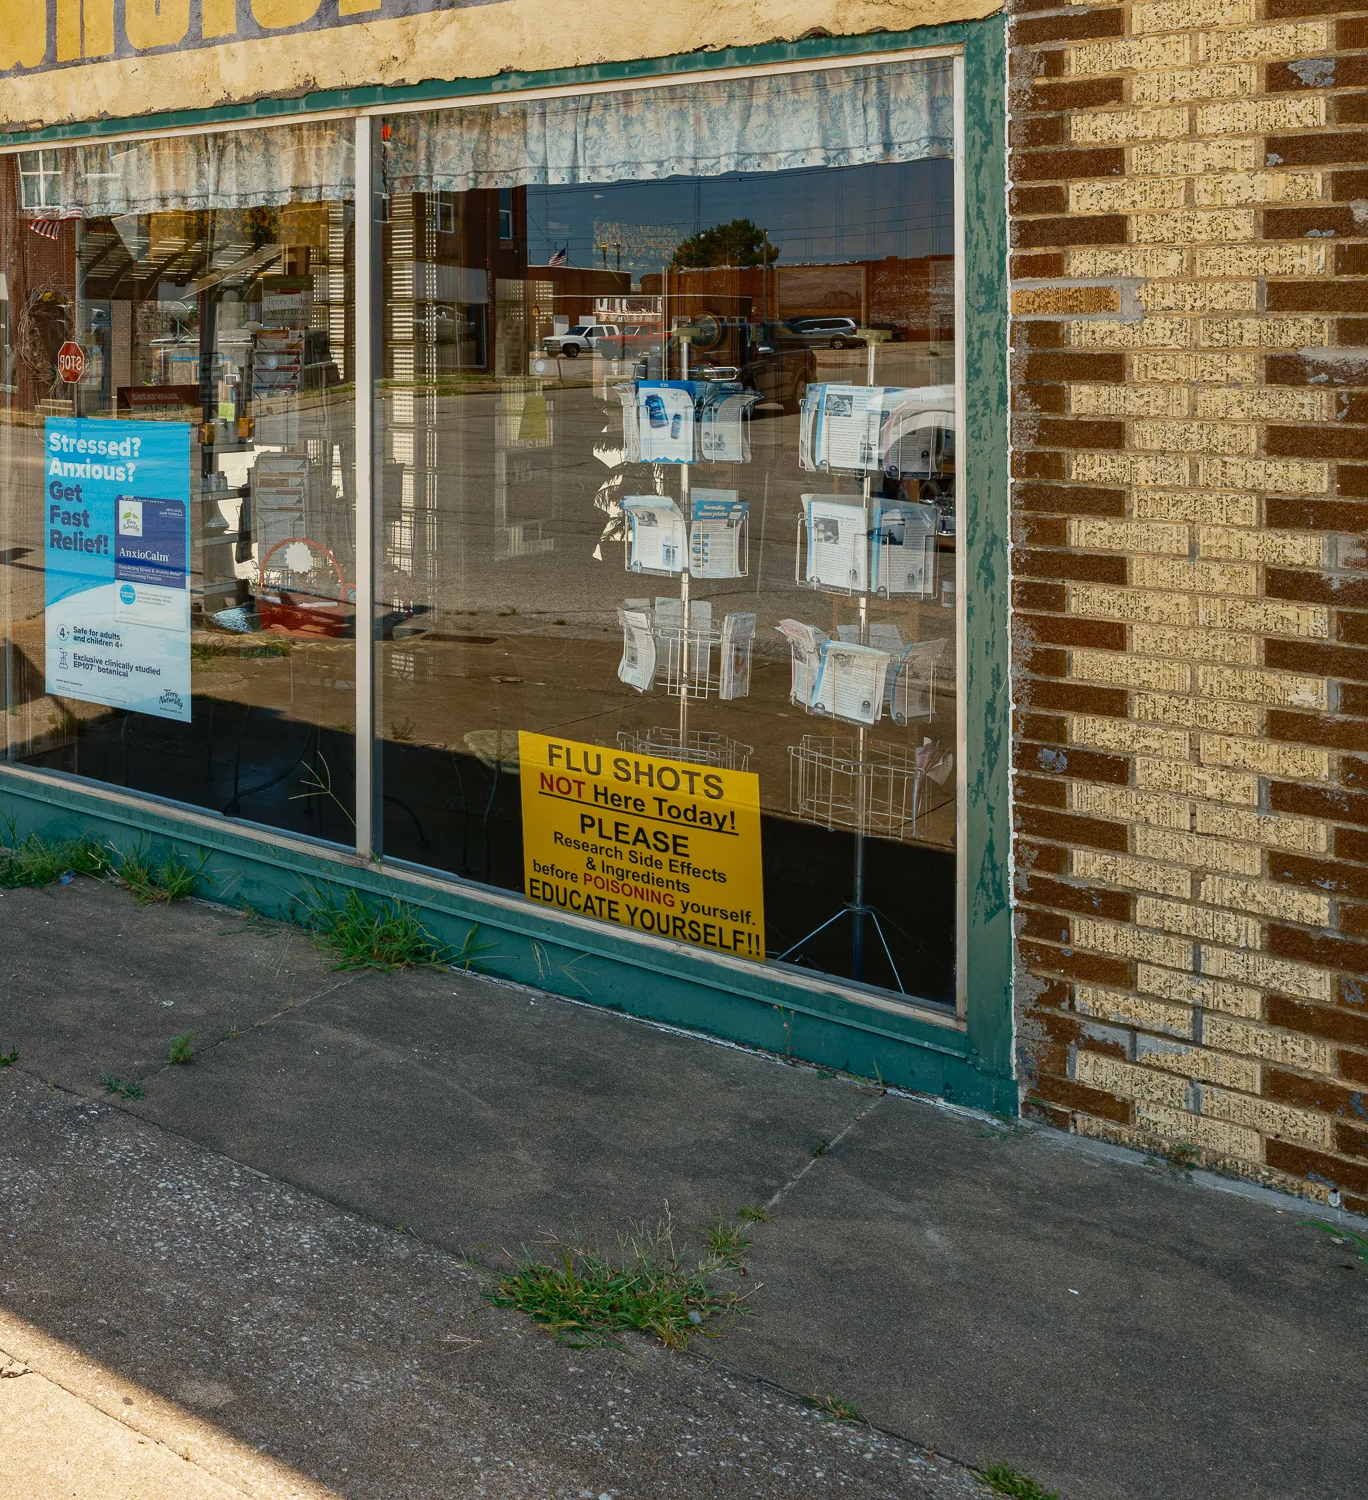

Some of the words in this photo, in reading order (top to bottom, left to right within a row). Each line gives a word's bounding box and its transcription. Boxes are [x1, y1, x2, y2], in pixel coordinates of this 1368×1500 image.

[49, 432, 142, 458] Stressed?
[49, 457, 136, 482] Anxious?
[49, 481, 82, 503] Get
[49, 505, 90, 529] Fast
[49, 529, 109, 555] Relief!
[73, 626, 88, 635] Safe
[89, 627, 99, 636] for
[100, 629, 120, 640] adults
[73, 635, 86, 643] and
[87, 636, 113, 648] children
[112, 641, 123, 649] 4+
[73, 653, 104, 665] Exclusive
[104, 658, 134, 672] clinically
[135, 663, 161, 676] studied
[97, 665, 129, 678] botanical
[164, 688, 178, 699] Terry
[547, 743, 602, 776] FLU
[612, 757, 725, 800] SHOTS
[539, 771, 586, 799] NOT
[593, 784, 646, 812] Here
[653, 796, 736, 831] Today!
[580, 813, 690, 858] PLEASE
[553, 831, 623, 861] Research
[628, 850, 664, 870] Side
[668, 858, 728, 884] Effects
[585, 856, 597, 872] &
[601, 861, 691, 894] Ingredients
[533, 859, 579, 883] before
[583, 872, 676, 908] POISONING
[679, 898, 757, 926] yourself.
[529, 877, 620, 923] EDUCATE
[625, 903, 761, 956] YOURSELF!!
